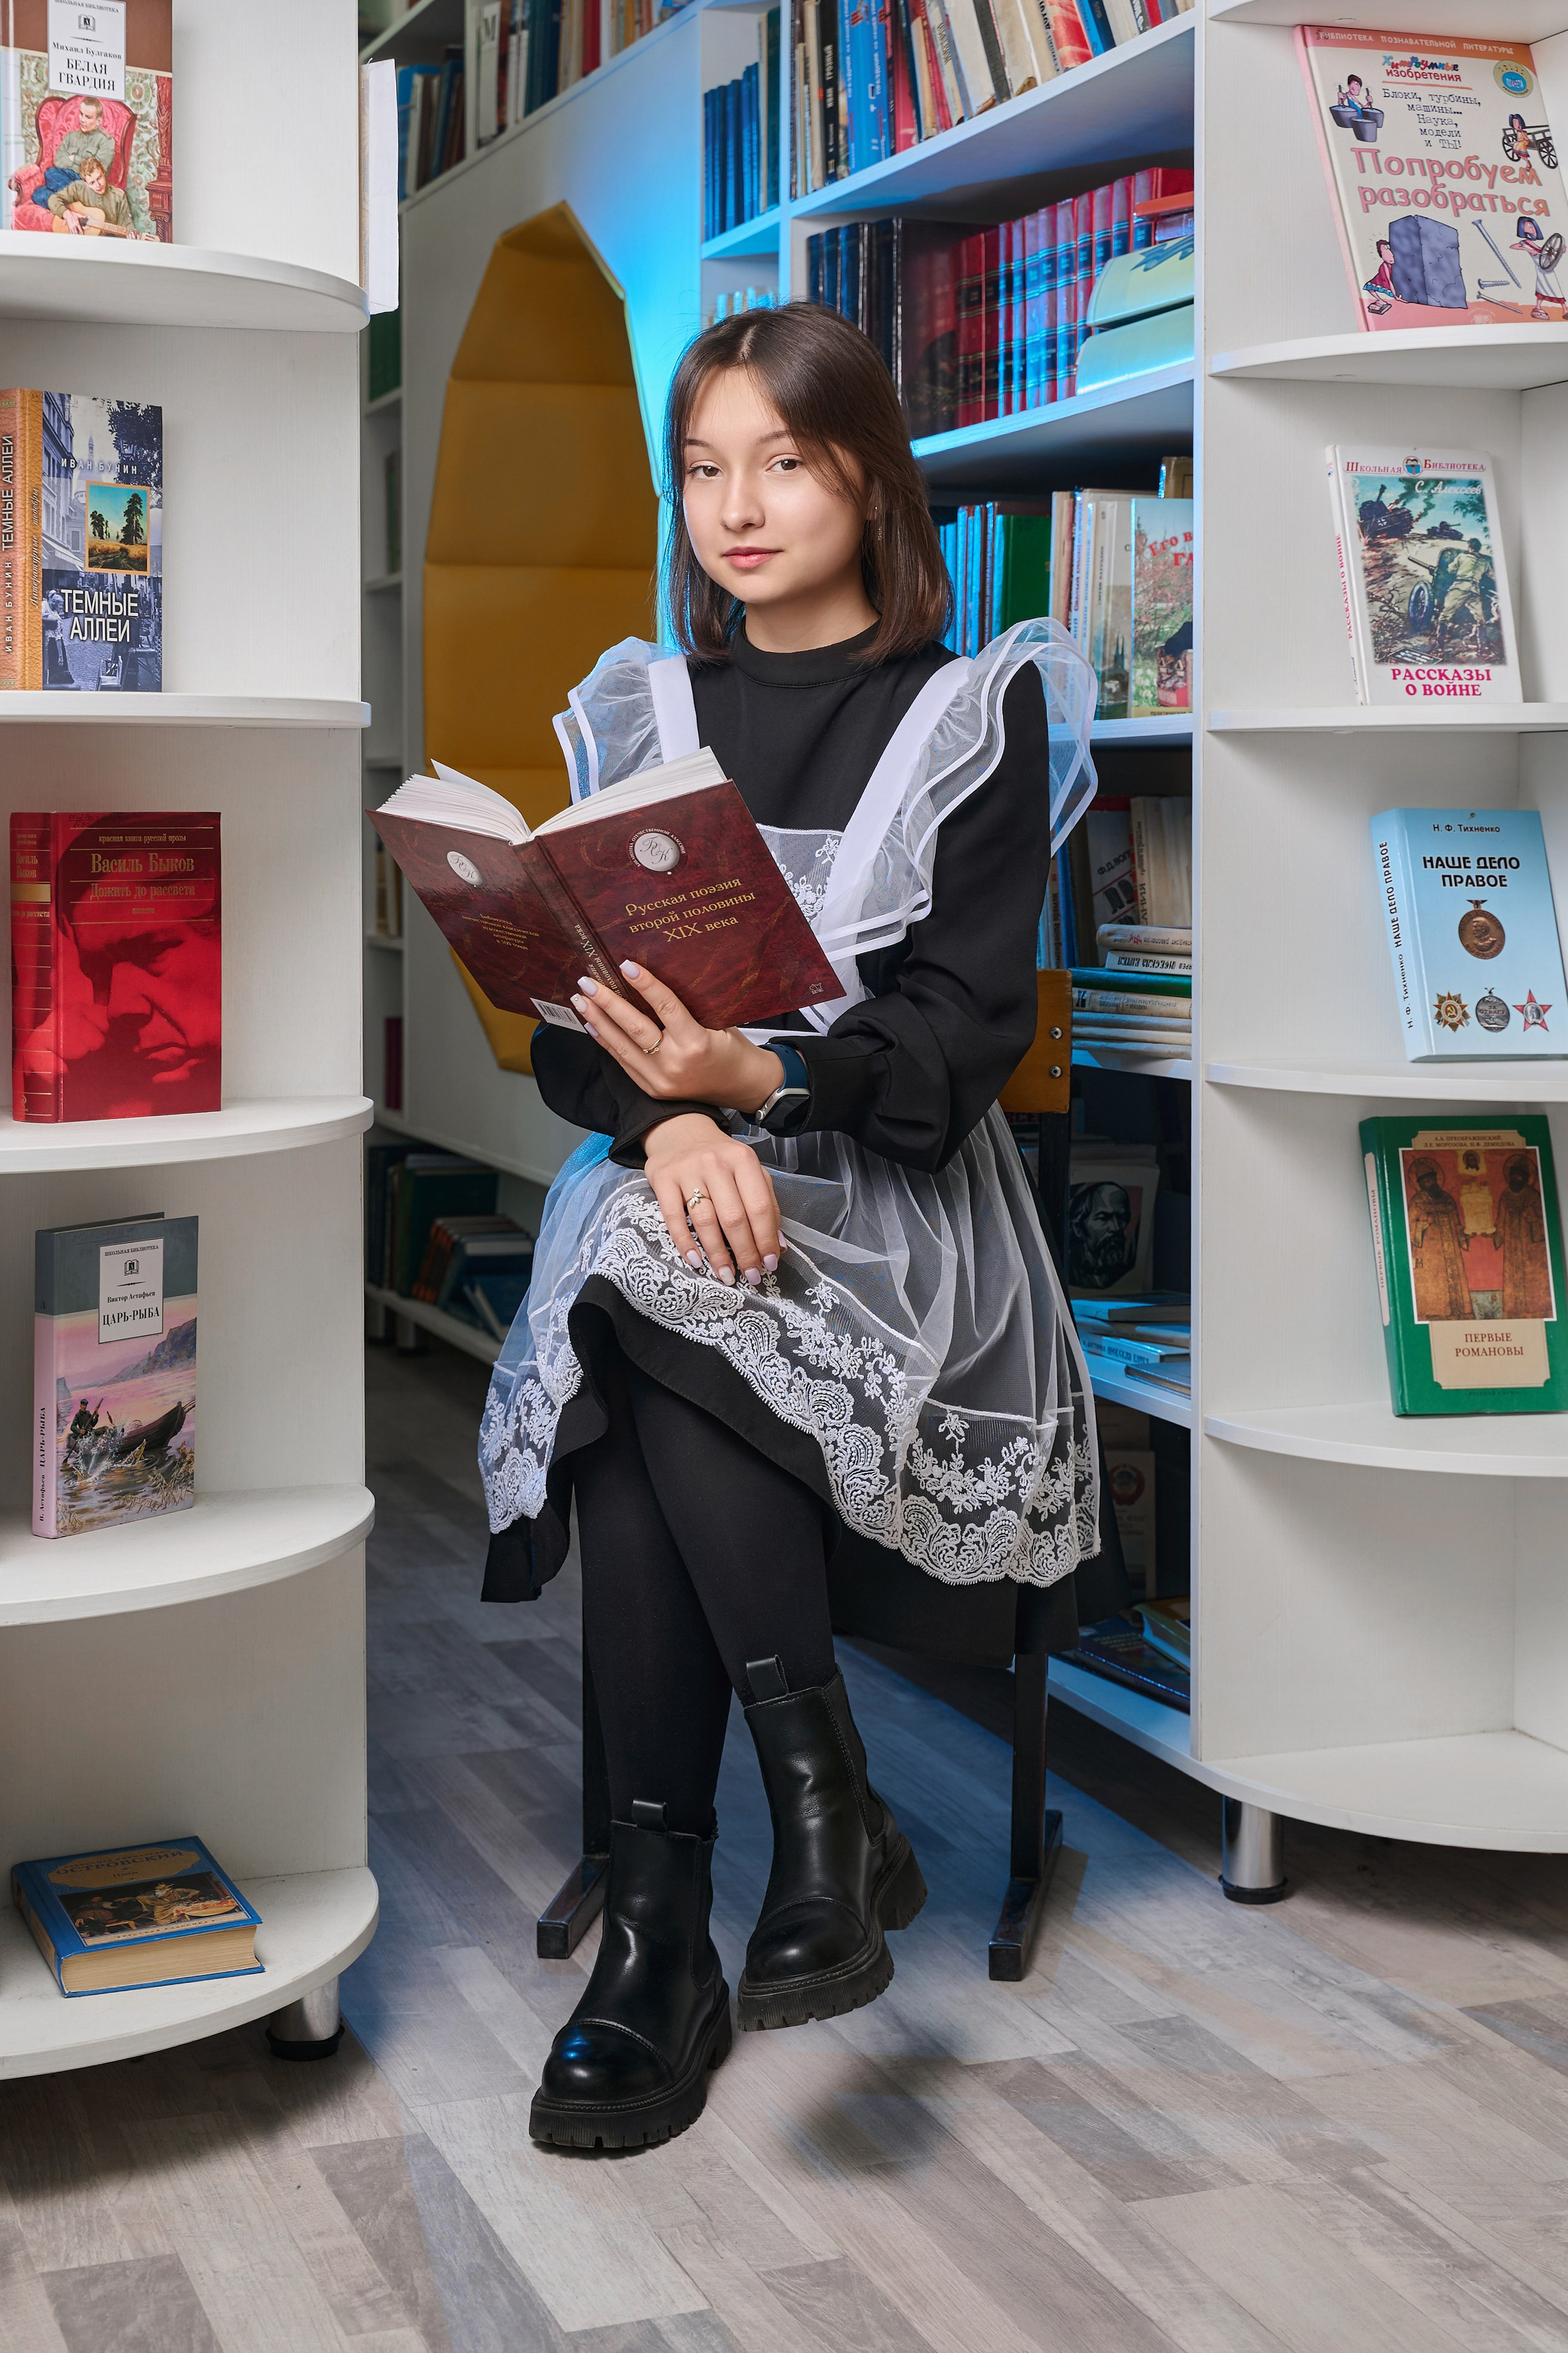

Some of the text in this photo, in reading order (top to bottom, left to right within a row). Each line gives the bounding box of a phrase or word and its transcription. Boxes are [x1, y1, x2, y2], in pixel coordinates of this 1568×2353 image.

[53, 42, 122, 59] Михаил Булгаков
[1381, 35, 1457, 49] ПОЗНАВАТЕЛЬНОЙ
[1463, 42, 1514, 55] ЛИТЕРАТУРЫ
[66, 58, 107, 75] БЕЛАЯ
[823, 44, 834, 80] ГРОЗНЫЙ
[59, 72, 115, 91] ГВАРДИЯ
[1386, 69, 1461, 82] изобретения
[1382, 88, 1481, 107] Блоки, турбины,
[1408, 104, 1462, 115] машины...
[1417, 114, 1458, 127] Наука,
[1419, 128, 1461, 137] модели
[1439, 139, 1462, 150] ТЫ!
[1351, 147, 1543, 189] Попробуем
[1358, 183, 1551, 217] разобраться
[2, 435, 13, 484] АЛЛЕИ
[61, 457, 137, 475] ИВАН БУНИН
[1415, 480, 1483, 495] С. Алексеев
[2, 489, 14, 552] ТЕМНЫЕ
[1149, 536, 1178, 557] Его
[1335, 533, 1344, 568] ВОЙНЕ
[61, 589, 139, 617] ТЕМНЫЕ
[1341, 581, 1352, 640] РАССКАЗЫ
[70, 616, 130, 643] АЛЛЕИ
[1391, 668, 1492, 682] РАССКАЗЫ
[1405, 681, 1482, 696] О ВОЙНЕ
[1433, 824, 1501, 834] Н. Ф. Тихненко
[99, 835, 123, 844] красная
[144, 834, 167, 844] русской
[168, 835, 186, 843] прозы
[91, 853, 195, 873] Василь Быков
[1379, 841, 1393, 884] ПРАВОЕ
[1423, 856, 1521, 870] НАШЕ ДЕЛО
[1441, 875, 1508, 887] ПРАВОЕ
[90, 884, 195, 902] Дожить до рассвета
[625, 878, 742, 917] Русская поэзия
[1387, 886, 1398, 914] ДЕЛО
[629, 892, 756, 933] второй половины
[705, 916, 739, 932] века
[1389, 917, 1402, 948] НАШЕ
[1398, 954, 1409, 1001] Тихненко
[1371, 1190, 1380, 1245] РОМАНОВЫ
[105, 1244, 159, 1257] ШКОЛЬНАЯ БИБЛИОТЕКА
[129, 1291, 156, 1301] Астафьев
[102, 1306, 160, 1327] ЦАРЬ-РЫБА
[1464, 1332, 1513, 1343] ПЕРВЫЕ
[1455, 1346, 1524, 1357] РОМАНОВЫ
[56, 1850, 184, 1875] ОСТРОВСКИЙ
